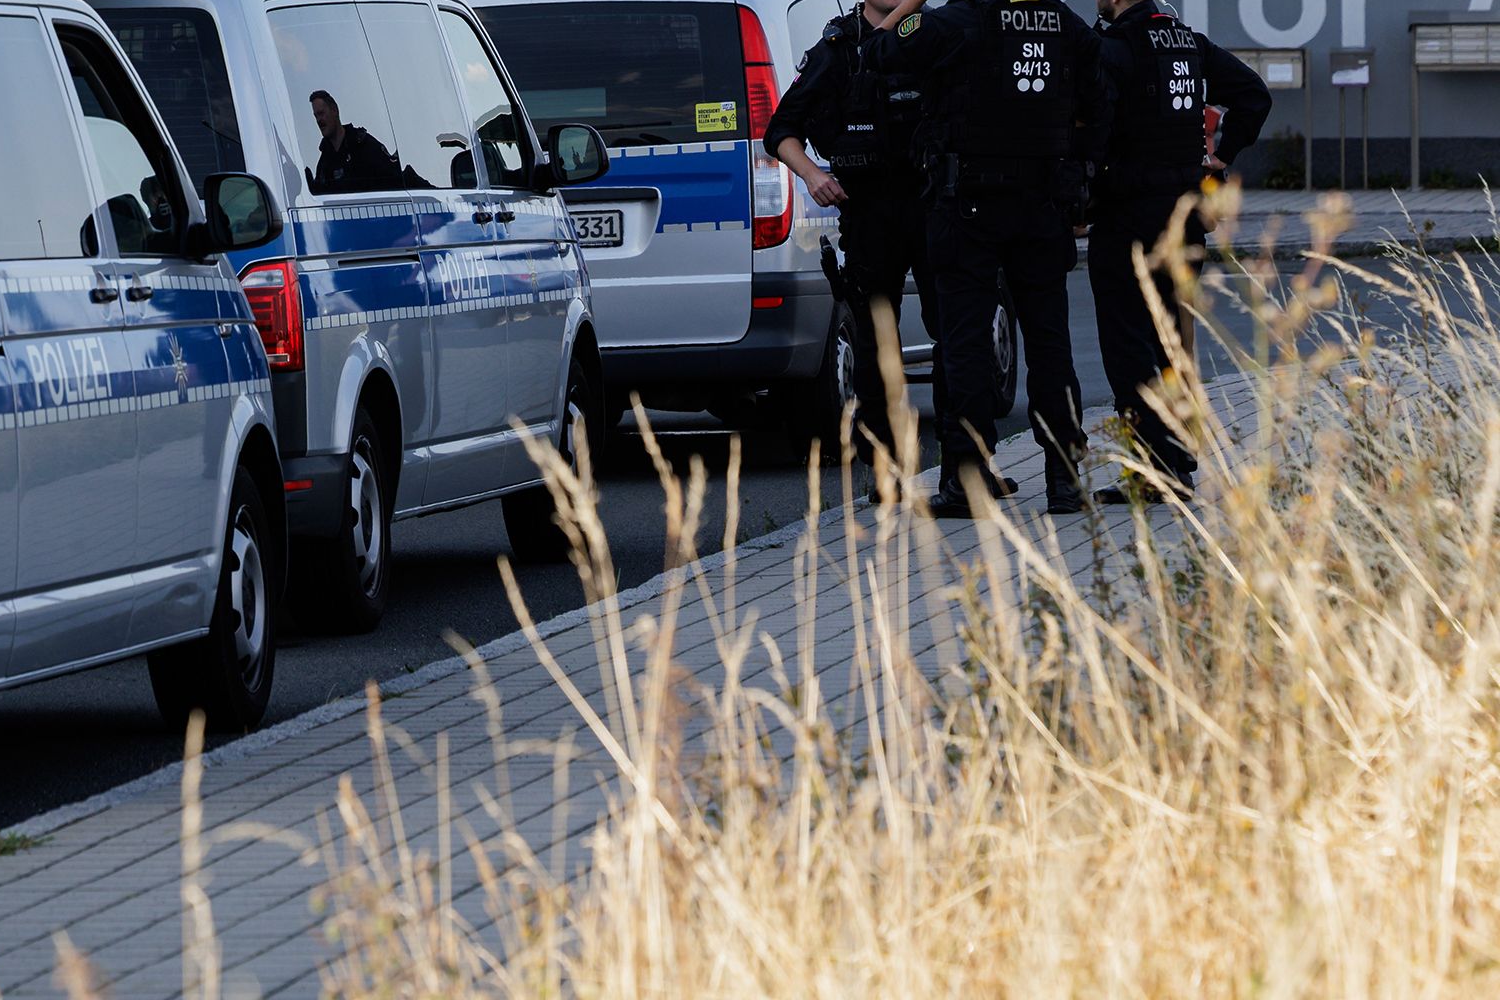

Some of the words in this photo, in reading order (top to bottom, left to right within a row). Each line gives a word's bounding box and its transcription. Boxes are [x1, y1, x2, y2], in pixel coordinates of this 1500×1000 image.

[1001, 9, 1061, 32] POLIZEI
[1148, 28, 1197, 49] POLIZEI
[1022, 42, 1044, 58] SN
[1013, 61, 1050, 76] 94/13
[1173, 61, 1189, 76] SN
[1169, 79, 1195, 94] 94/11
[830, 153, 867, 167] POLIZEI
[435, 250, 491, 300] POLIZEI
[26, 336, 112, 407] POLIZEI
